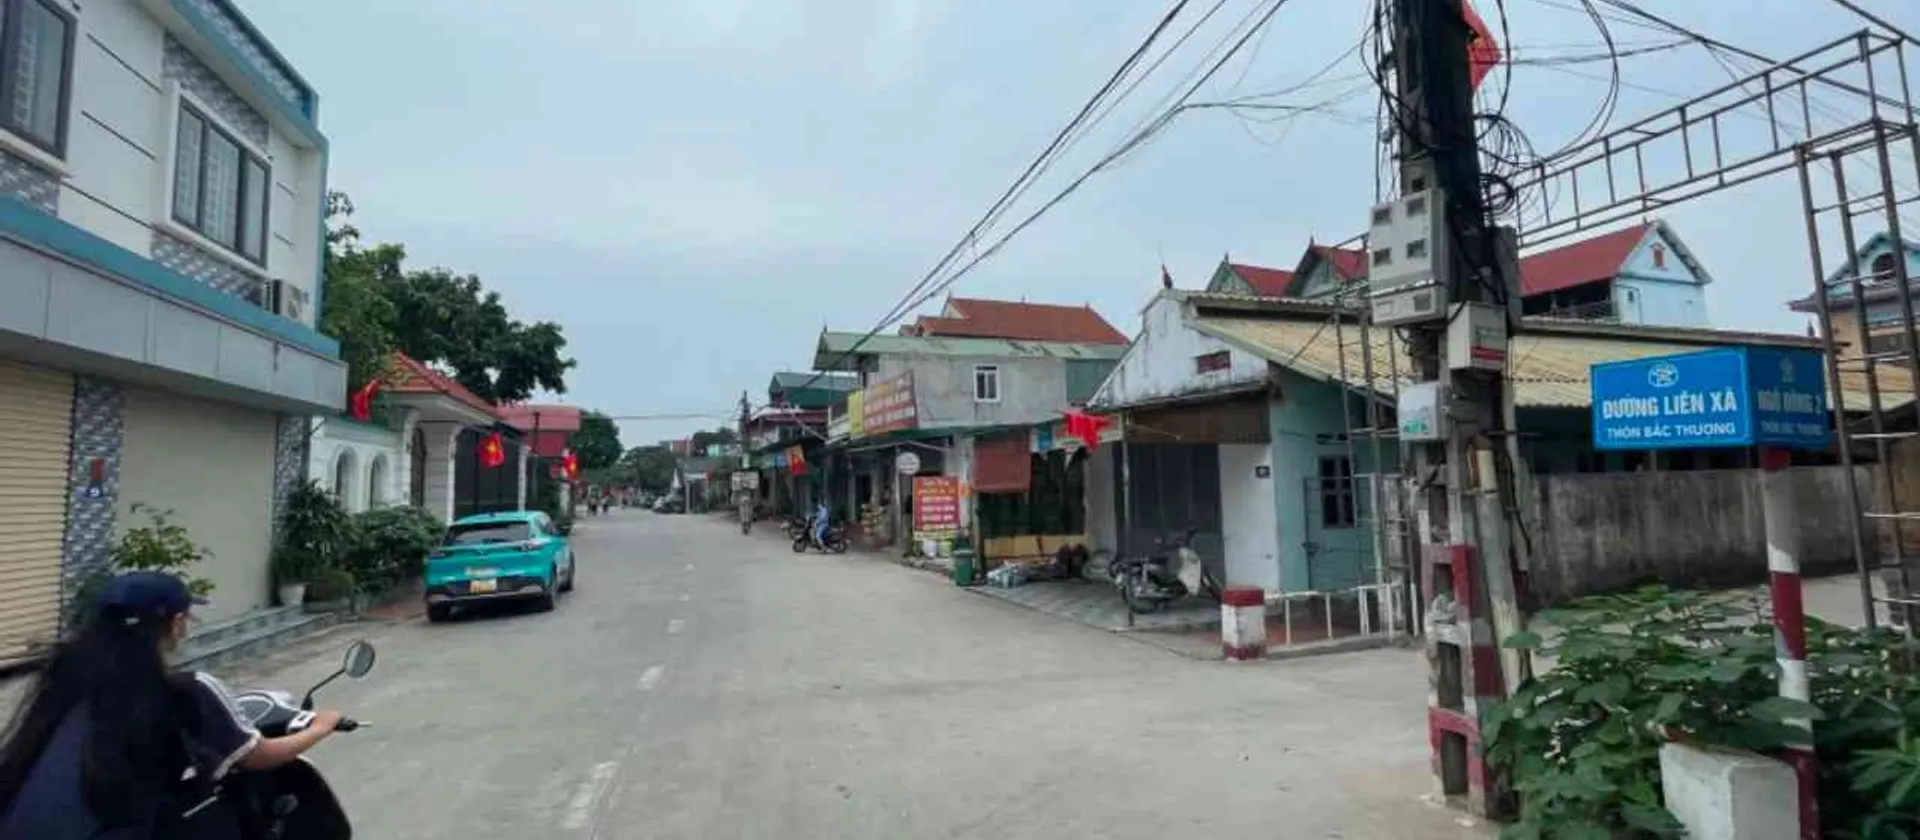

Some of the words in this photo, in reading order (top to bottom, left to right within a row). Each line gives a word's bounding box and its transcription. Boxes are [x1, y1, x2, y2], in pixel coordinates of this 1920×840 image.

[1602, 393, 1660, 420] ĐƯỜNG
[1664, 389, 1704, 415] LIÊN
[1708, 386, 1737, 412] XÃ
[1607, 424, 1642, 440] THÔN
